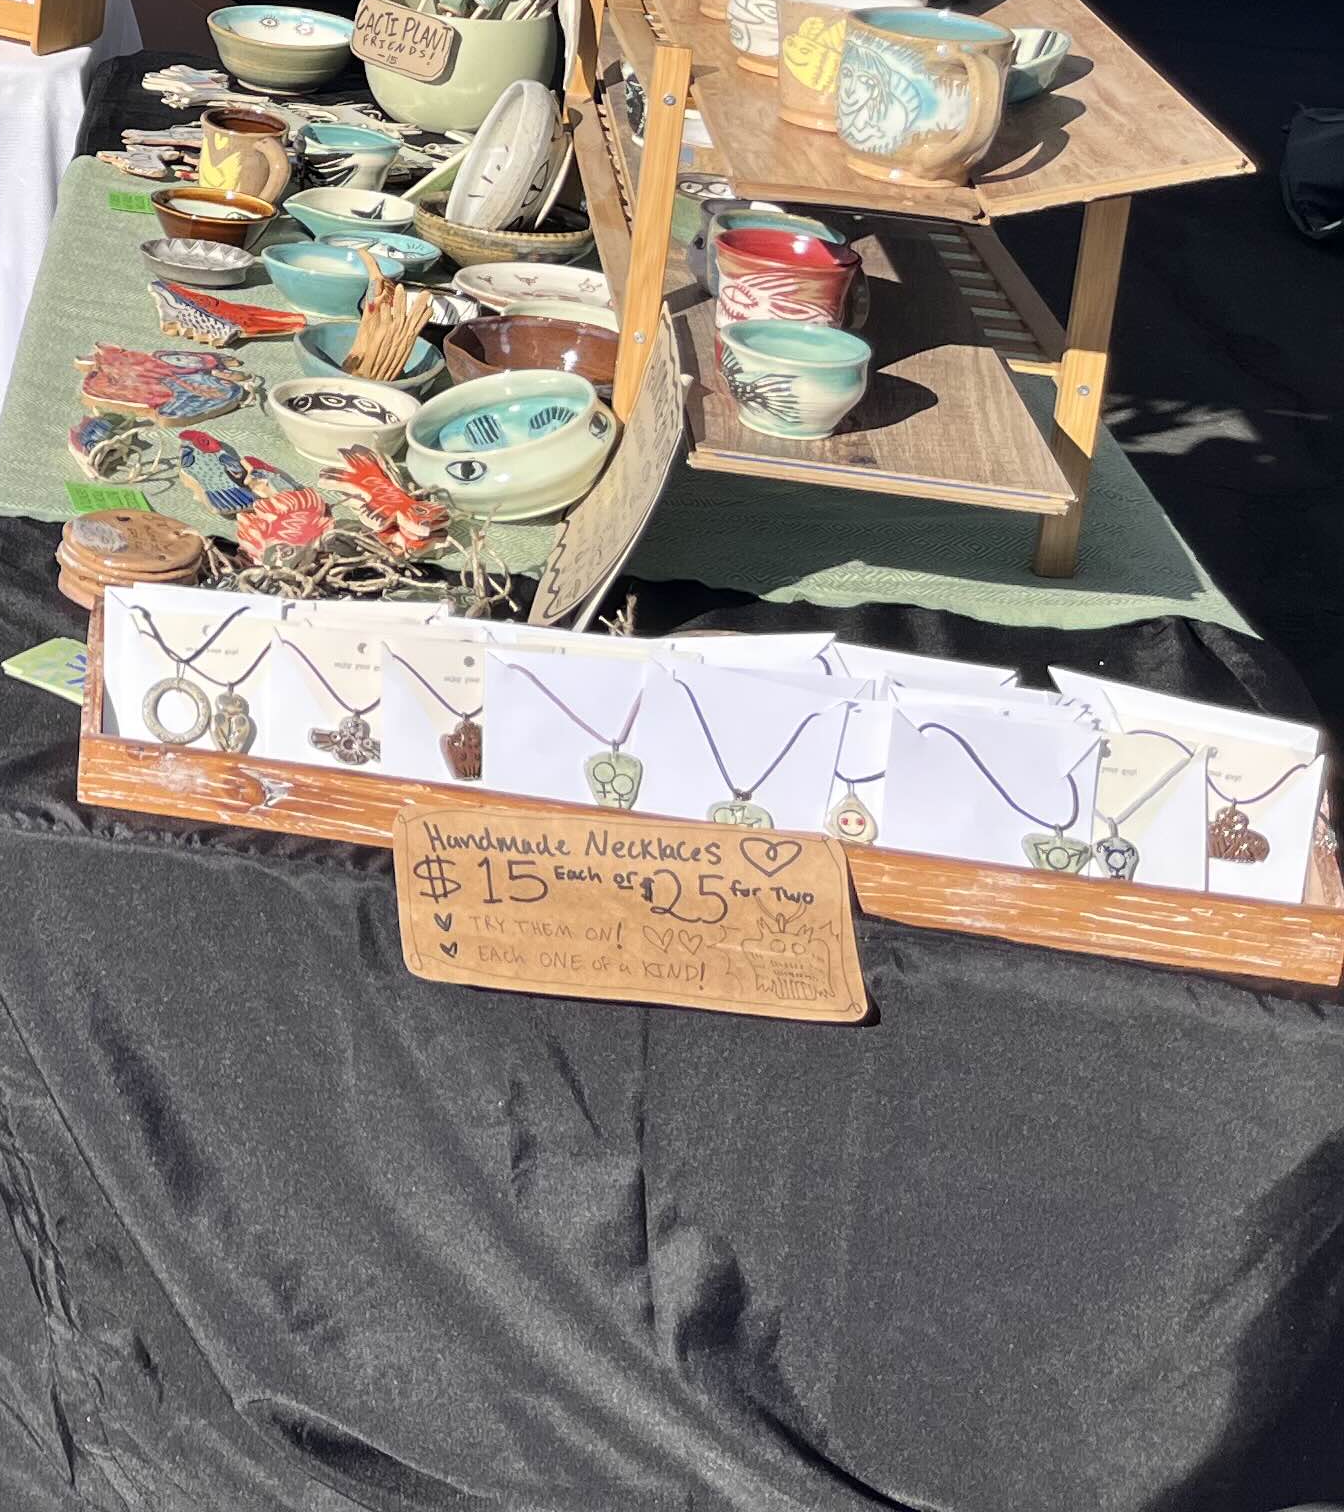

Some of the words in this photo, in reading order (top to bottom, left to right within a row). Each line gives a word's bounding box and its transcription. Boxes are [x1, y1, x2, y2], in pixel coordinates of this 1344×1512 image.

[356, 4, 400, 37] CACTI
[401, 16, 452, 52] PLANT
[422, 821, 572, 858] Handmade
[585, 829, 724, 867] Necklaces
[554, 864, 603, 884] Each
[613, 867, 640, 890] or
[728, 881, 761, 899] for
[468, 914, 515, 939] TRY
[516, 918, 573, 942] THEM
[584, 921, 627, 951] ON!
[538, 949, 586, 973] ONE
[641, 959, 708, 991] KIND!
